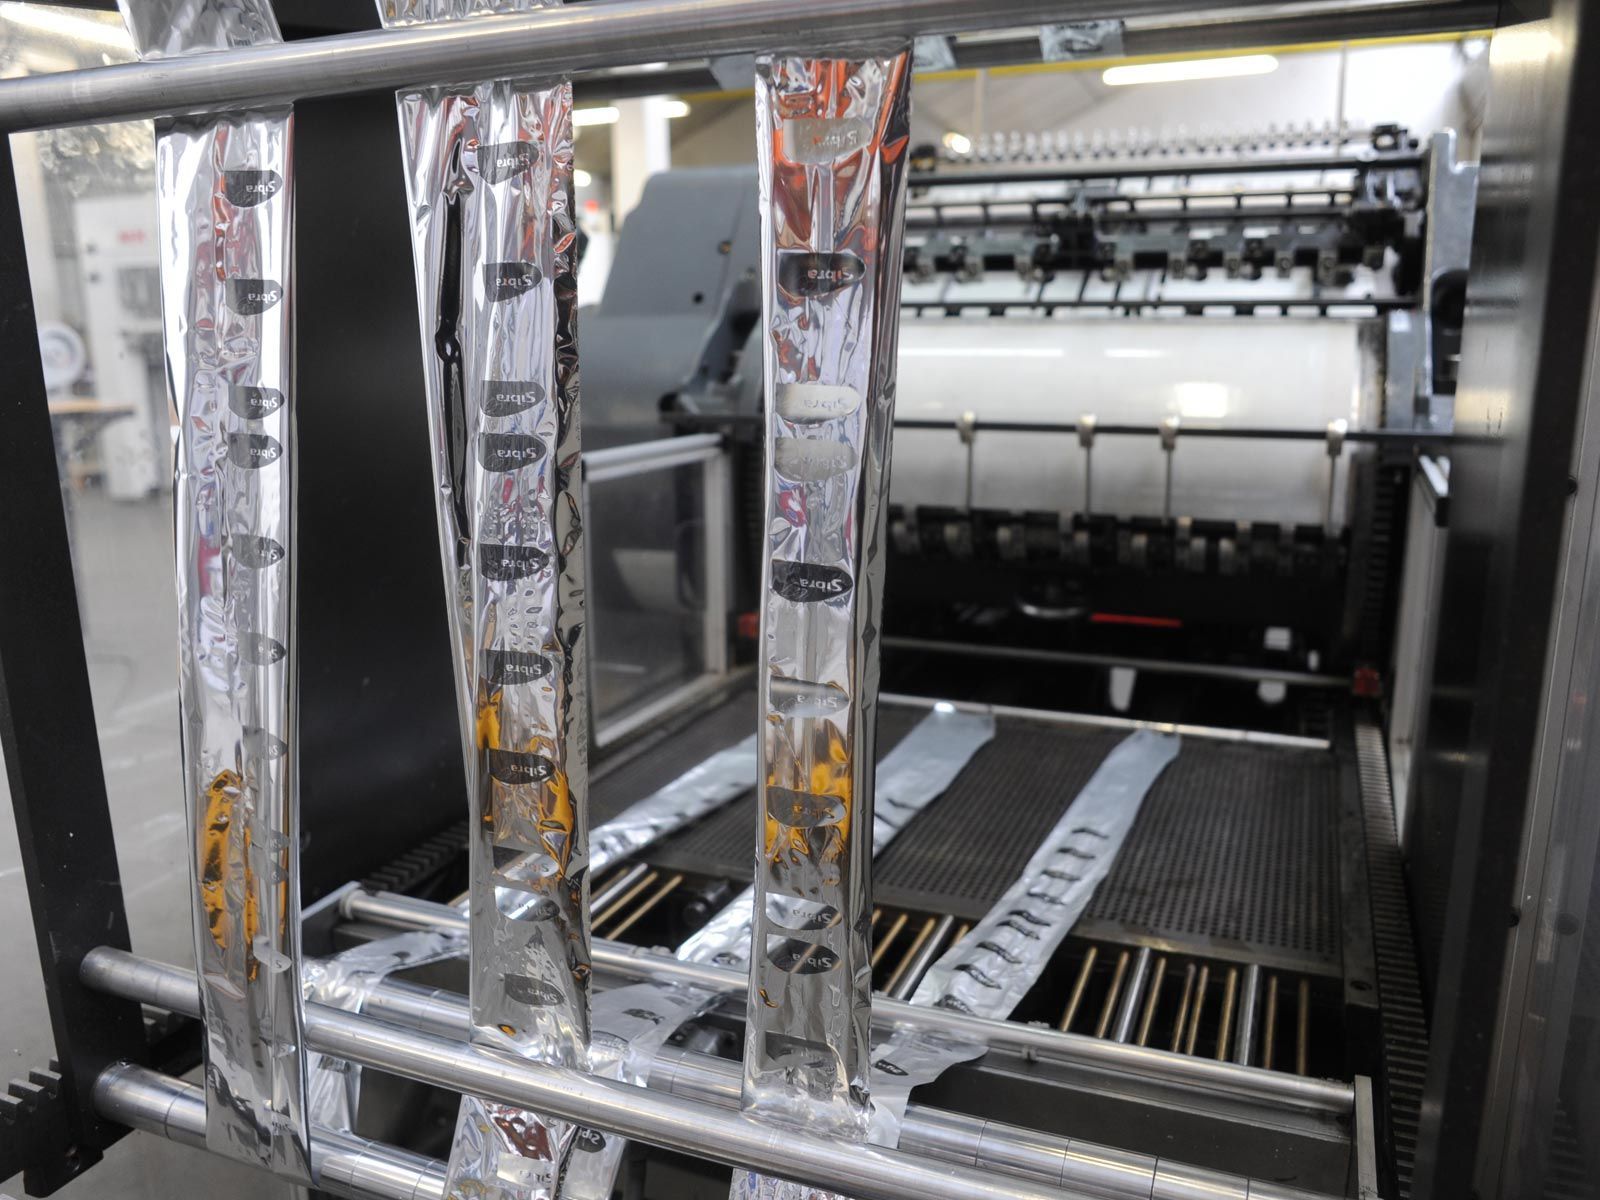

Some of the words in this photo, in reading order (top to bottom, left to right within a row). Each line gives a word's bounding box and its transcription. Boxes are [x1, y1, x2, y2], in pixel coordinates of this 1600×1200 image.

[245, 180, 276, 195] Sibra
[495, 273, 533, 289] Sibra
[807, 267, 855, 283] Sibra
[248, 290, 278, 303] Sibra
[250, 397, 278, 410] Sibra
[495, 391, 536, 406] Sibra
[249, 447, 277, 460] Sibra
[497, 447, 537, 461] Sibra
[502, 557, 540, 571] Sibra
[801, 577, 843, 593] Sibra
[506, 664, 542, 675] Sibra
[797, 694, 838, 708] Siba
[511, 764, 547, 777] Sibra
[792, 909, 832, 924] Sibra
[792, 953, 832, 969] Siba
